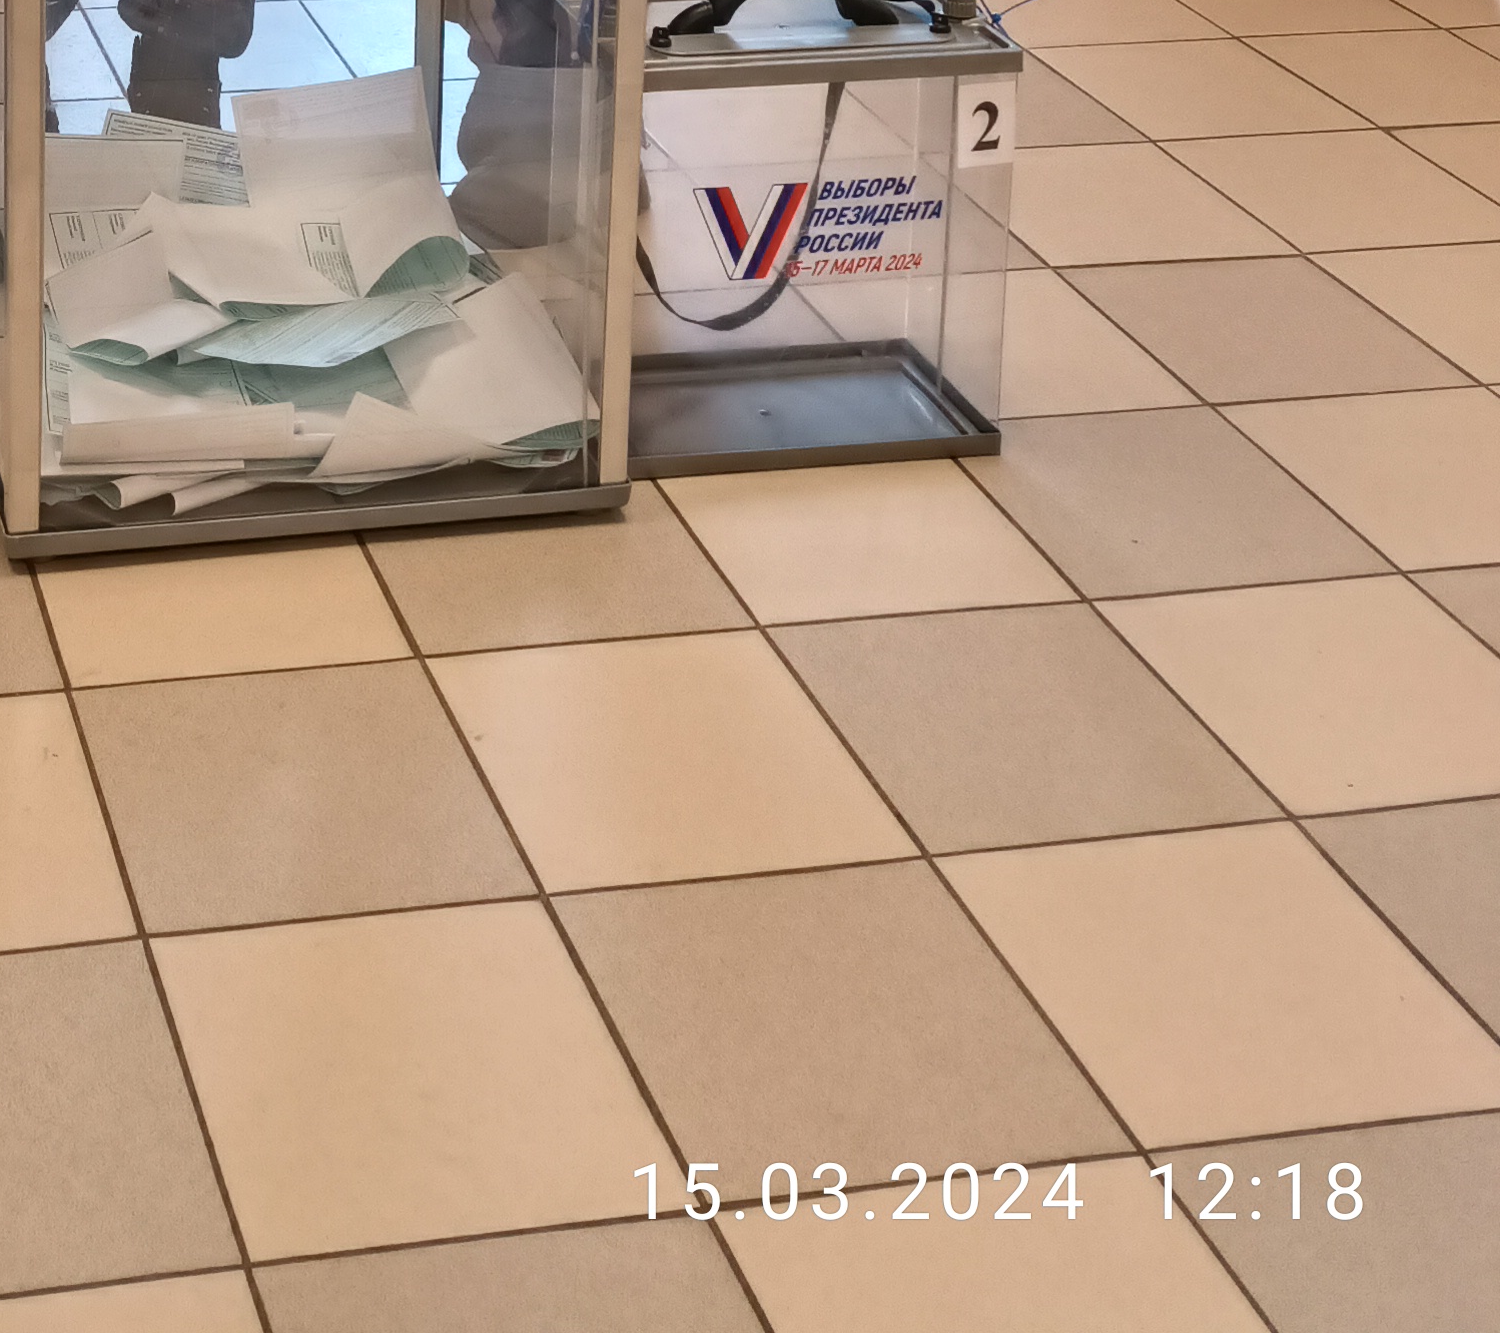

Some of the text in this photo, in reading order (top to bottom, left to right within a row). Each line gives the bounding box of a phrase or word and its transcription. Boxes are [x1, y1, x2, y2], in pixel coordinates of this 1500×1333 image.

[970, 100, 1001, 152] 2
[818, 175, 917, 201] ВЫБОРЫ
[806, 199, 944, 228] ПРЕЗИДЕНТА
[794, 230, 885, 254] РОССИИ
[829, 255, 883, 275] МАРТА
[884, 252, 923, 272] 2024
